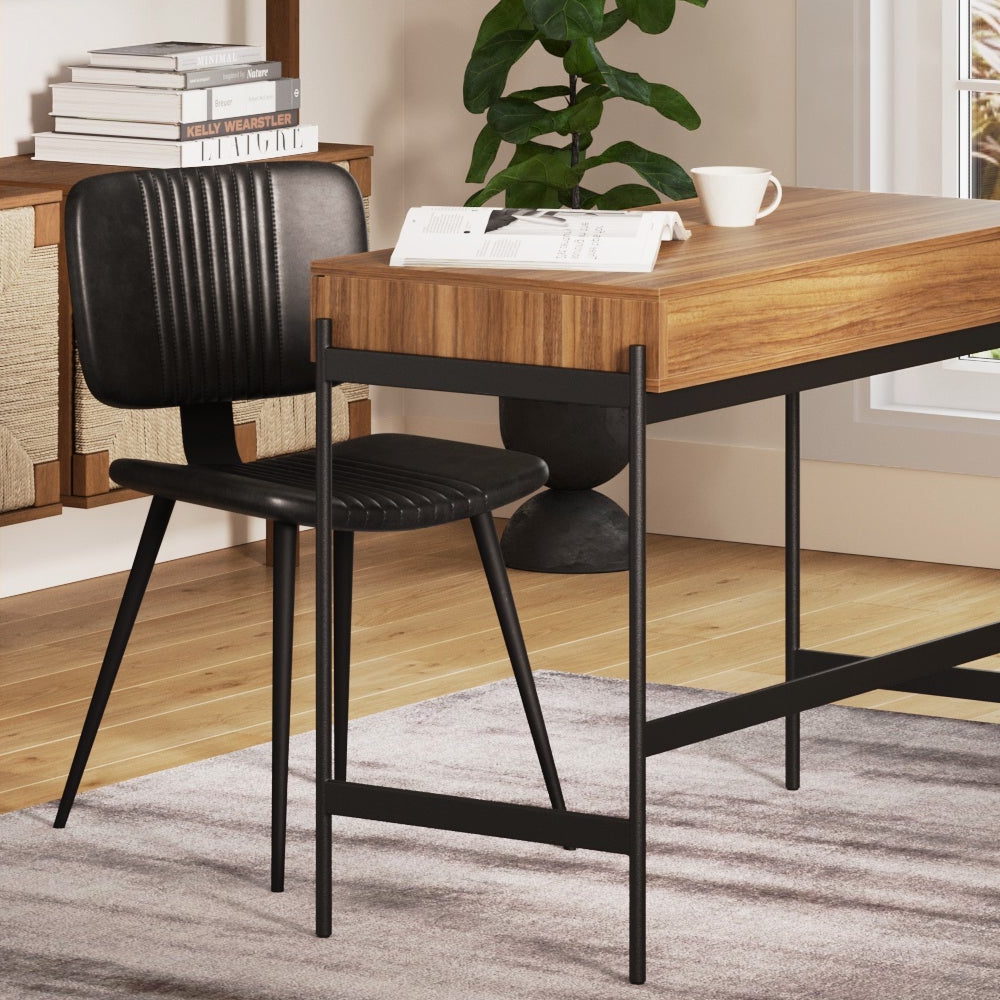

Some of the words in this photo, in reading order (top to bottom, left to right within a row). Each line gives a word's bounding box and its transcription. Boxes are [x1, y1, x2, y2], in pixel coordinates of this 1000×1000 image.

[246, 68, 269, 80] Nature
[186, 124, 221, 138] KELLY
[224, 113, 293, 133] WEARSTLER
